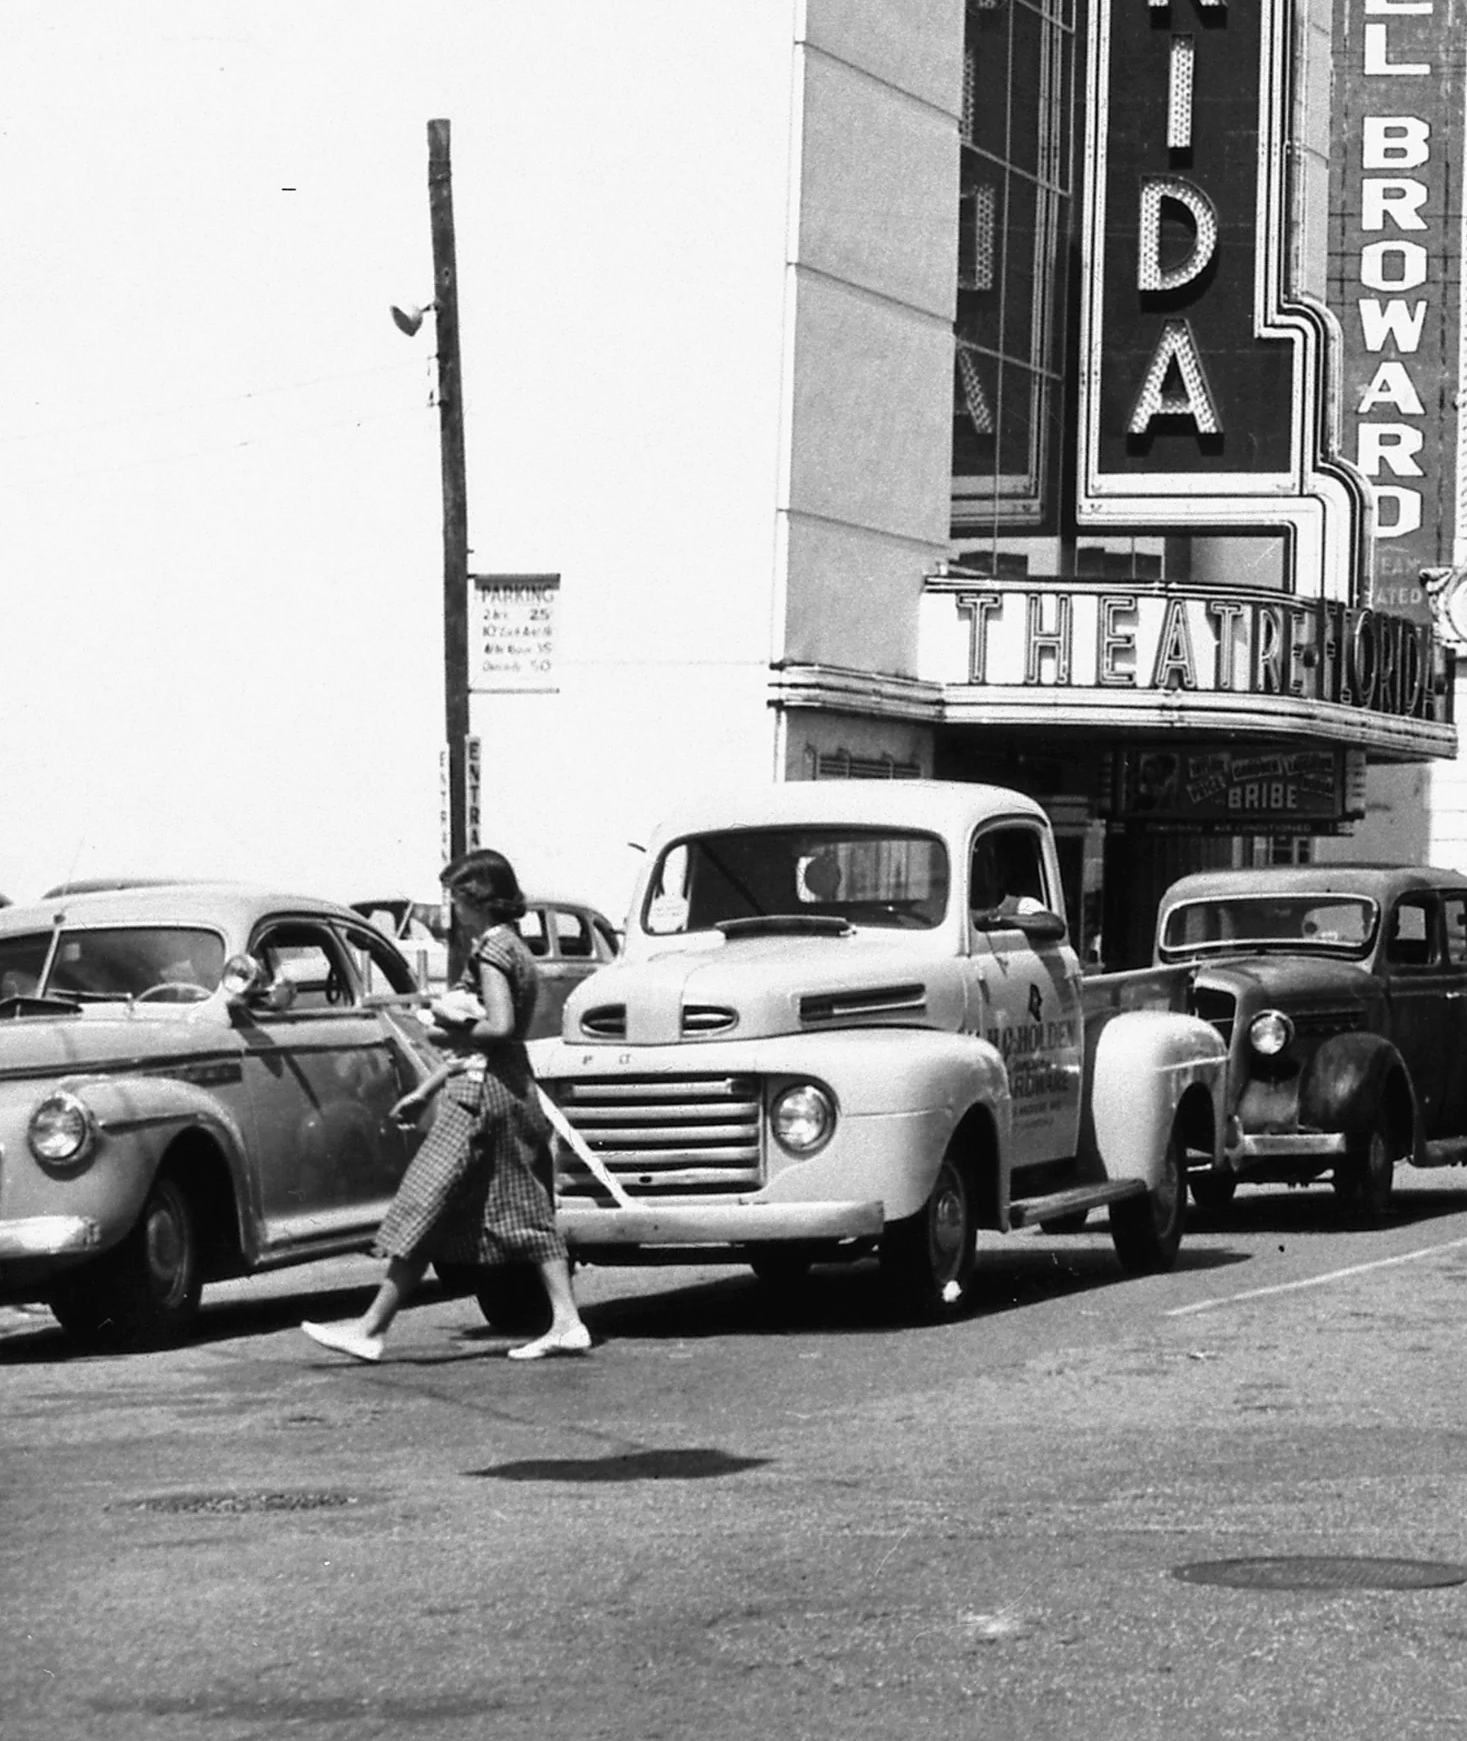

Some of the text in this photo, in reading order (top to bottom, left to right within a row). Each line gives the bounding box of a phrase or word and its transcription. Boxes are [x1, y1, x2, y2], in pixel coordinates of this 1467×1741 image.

[1358, 116, 1431, 539] BROWARD
[957, 593, 1306, 695] THEATRE
[469, 741, 481, 846] ENTRA
[1228, 782, 1298, 809] BRIBE
